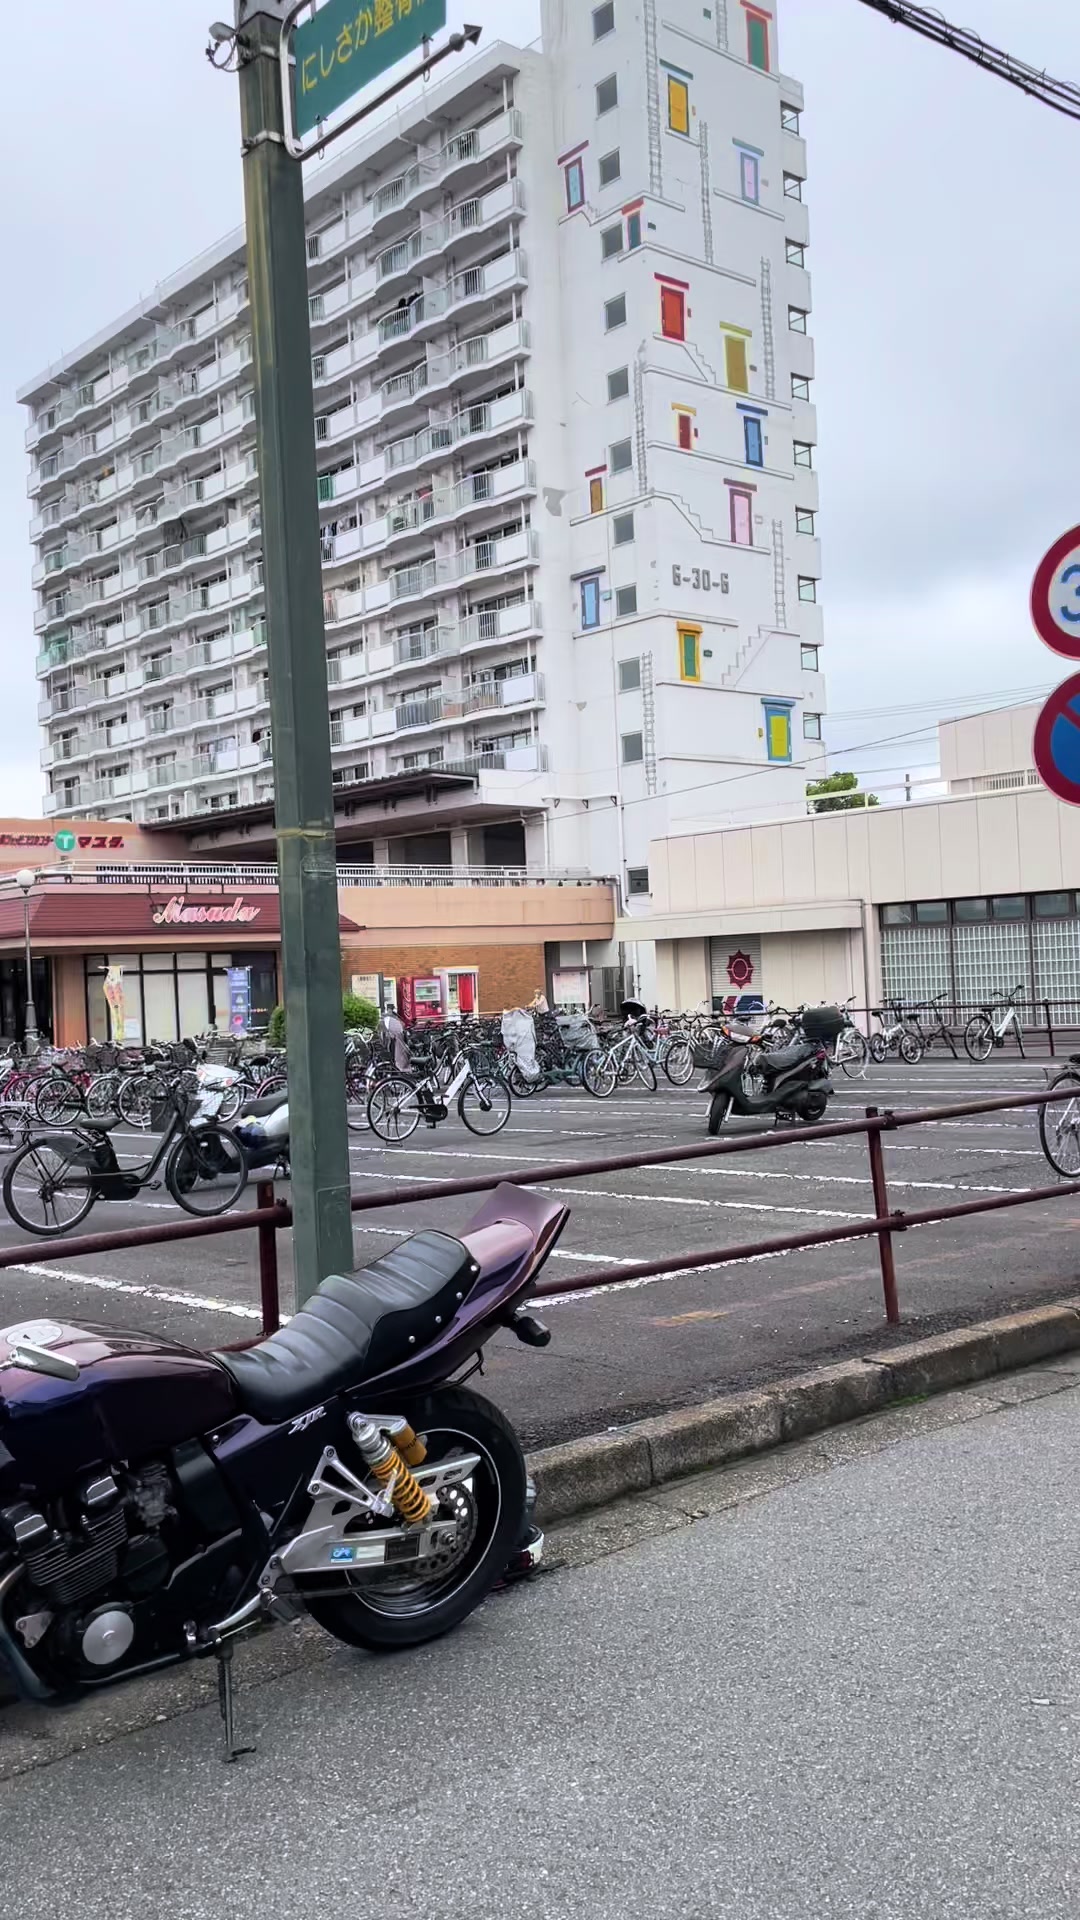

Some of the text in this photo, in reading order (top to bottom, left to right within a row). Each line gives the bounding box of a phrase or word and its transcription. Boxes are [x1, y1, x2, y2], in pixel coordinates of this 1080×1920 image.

[302, 0, 425, 96] にしさか整
[672, 564, 729, 594] 6-30-6
